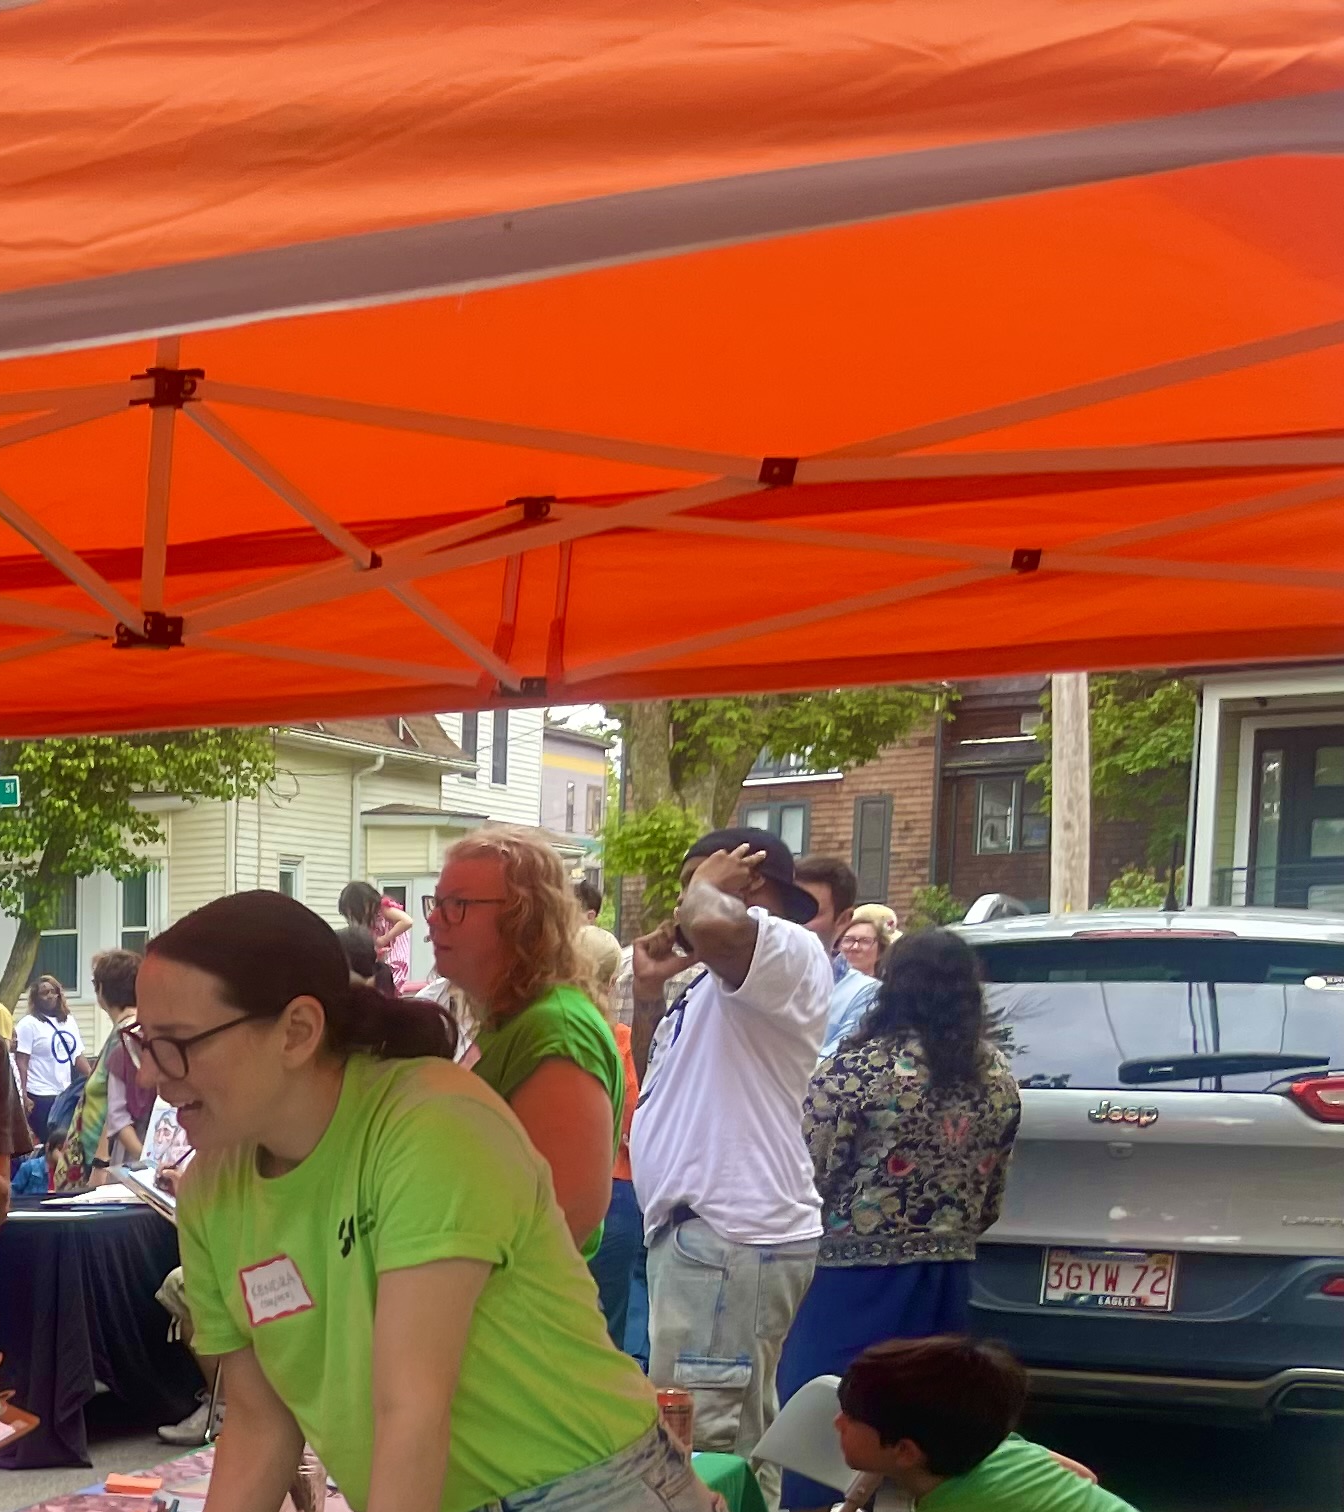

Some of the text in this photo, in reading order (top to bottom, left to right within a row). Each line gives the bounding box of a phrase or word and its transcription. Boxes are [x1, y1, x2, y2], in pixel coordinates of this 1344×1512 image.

[5, 782, 15, 794] ST
[1088, 1100, 1159, 1128] Jeep
[1047, 1261, 1168, 1296] 3GYW 72
[1097, 1295, 1137, 1307] EAGLES
